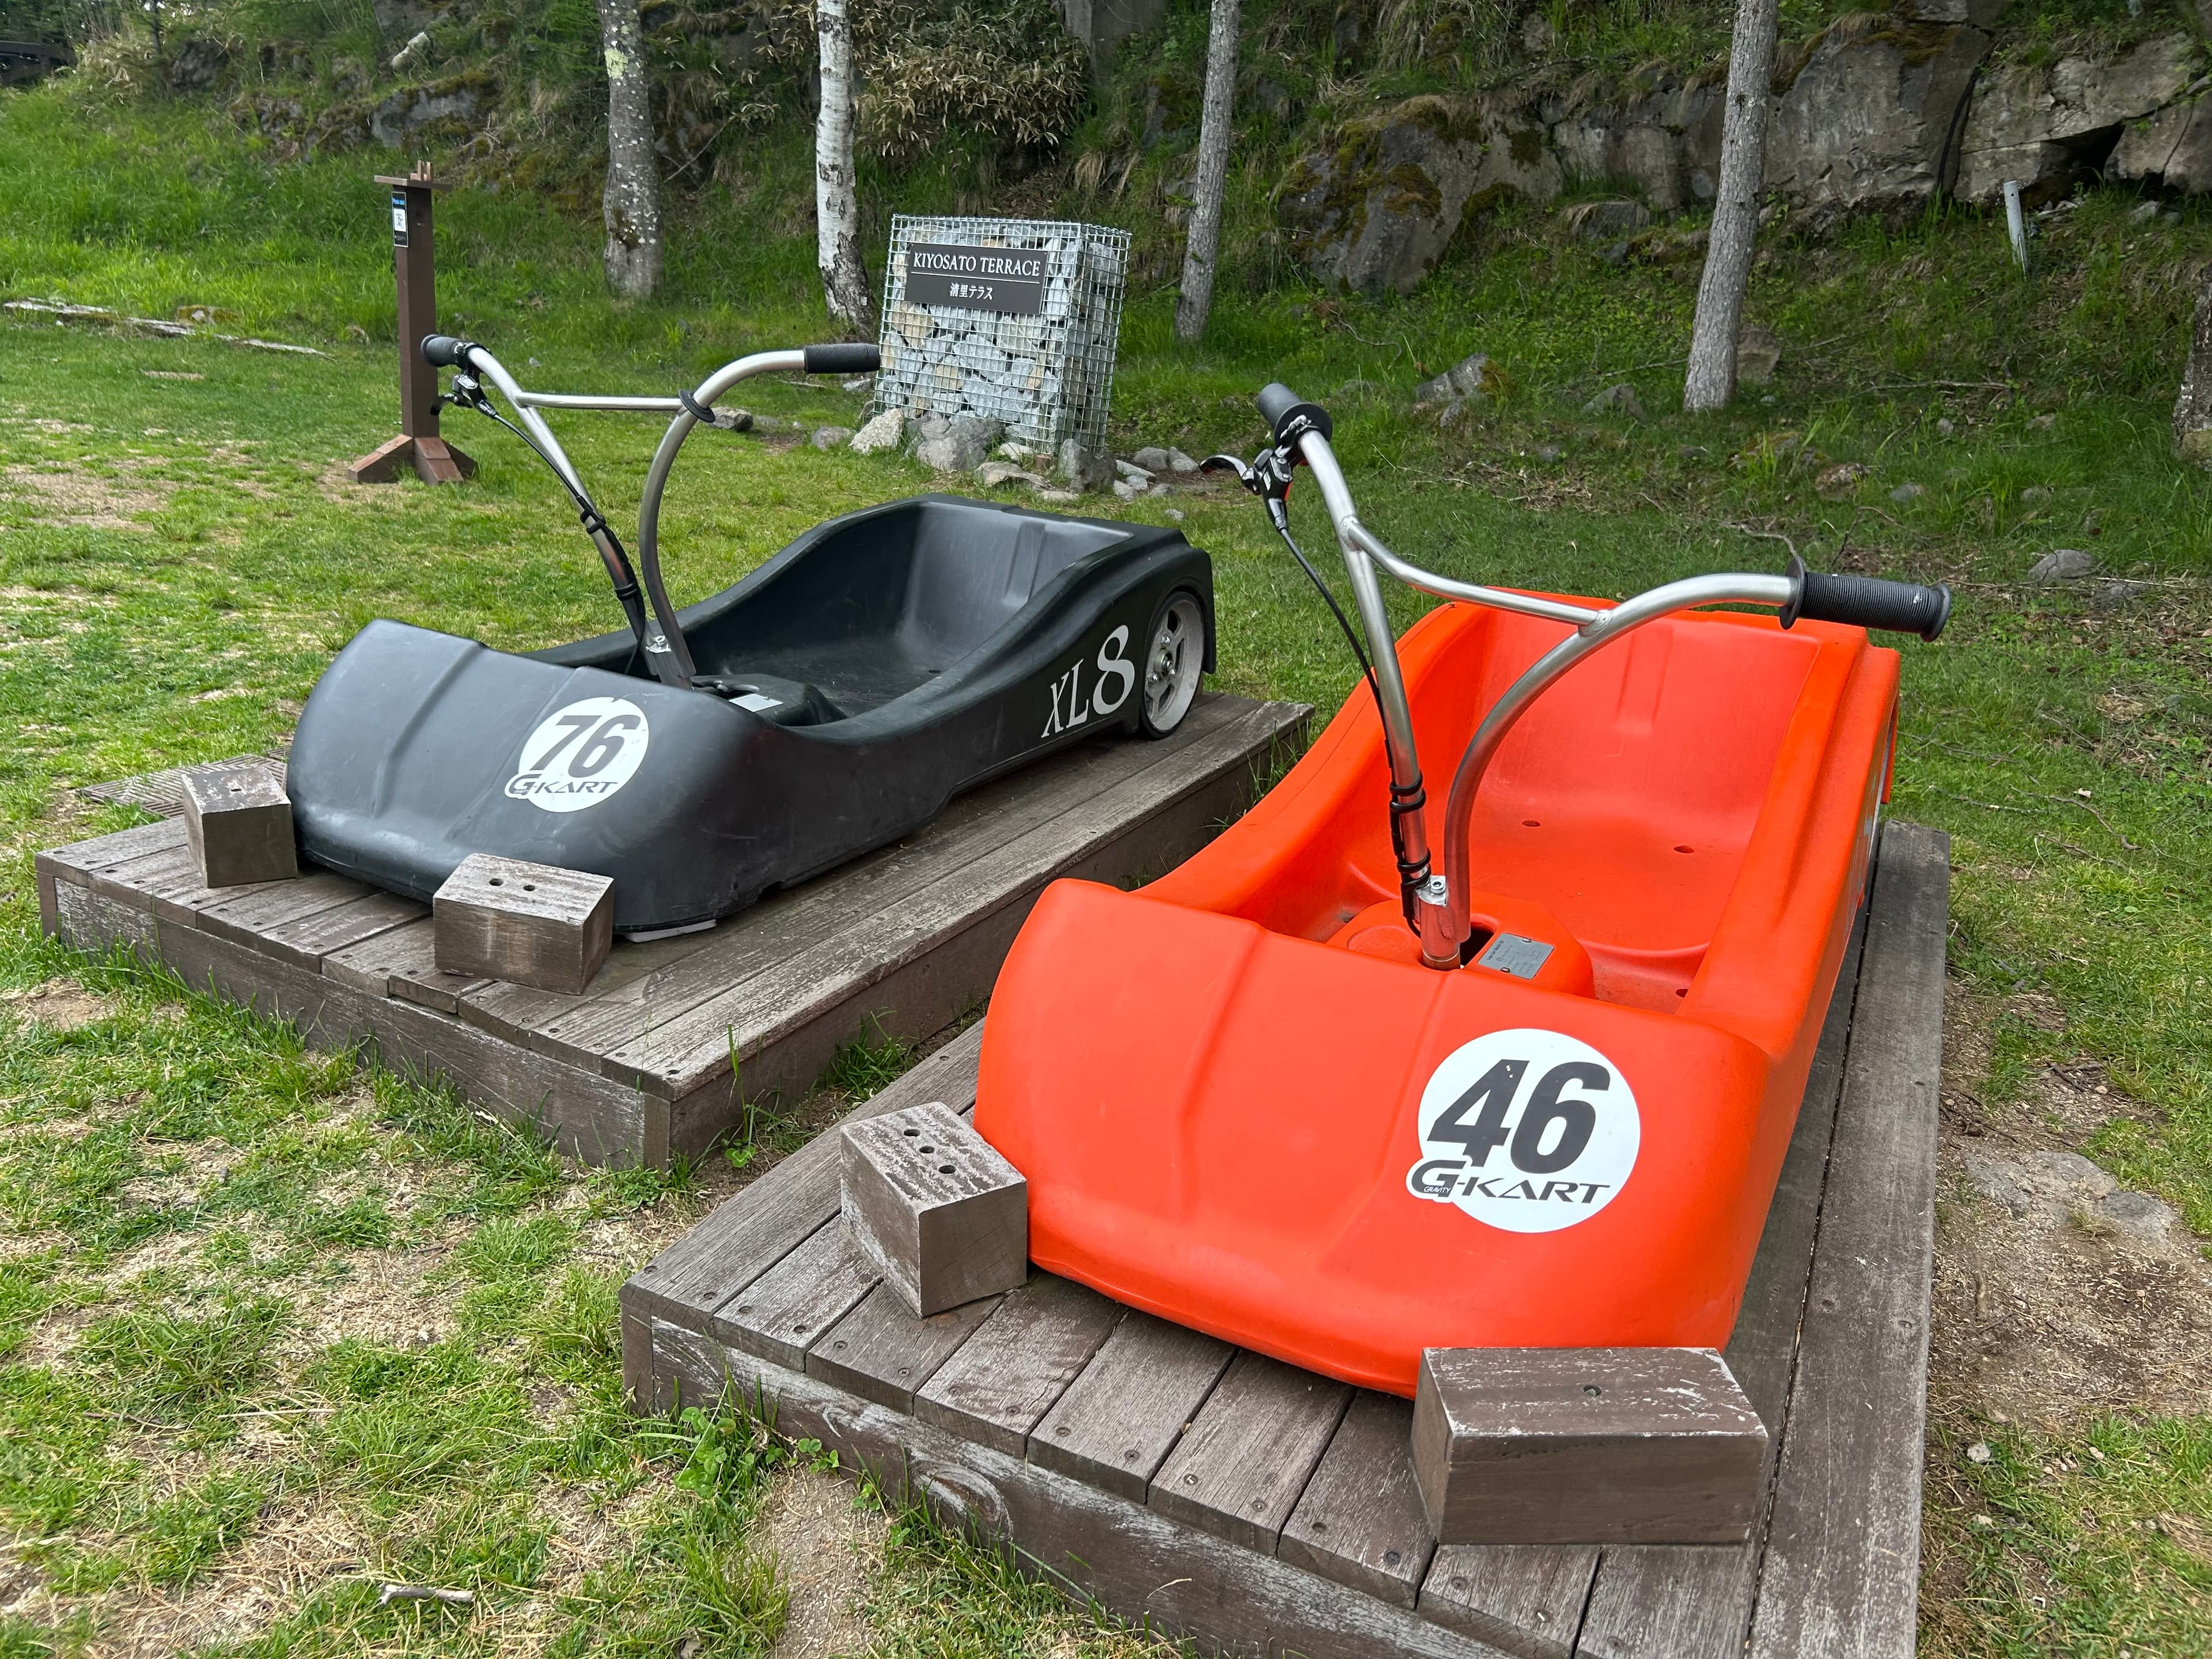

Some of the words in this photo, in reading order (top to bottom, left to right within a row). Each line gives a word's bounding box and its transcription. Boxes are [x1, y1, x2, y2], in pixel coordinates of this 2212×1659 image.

[913, 252, 976, 272] KIYOSATO
[980, 257, 1040, 277] TERRACE
[949, 282, 993, 300] 清里テラス
[529, 714, 641, 778] 76
[1427, 1059, 1611, 1174] 46
[1423, 1185, 1452, 1194] GRAVITY
